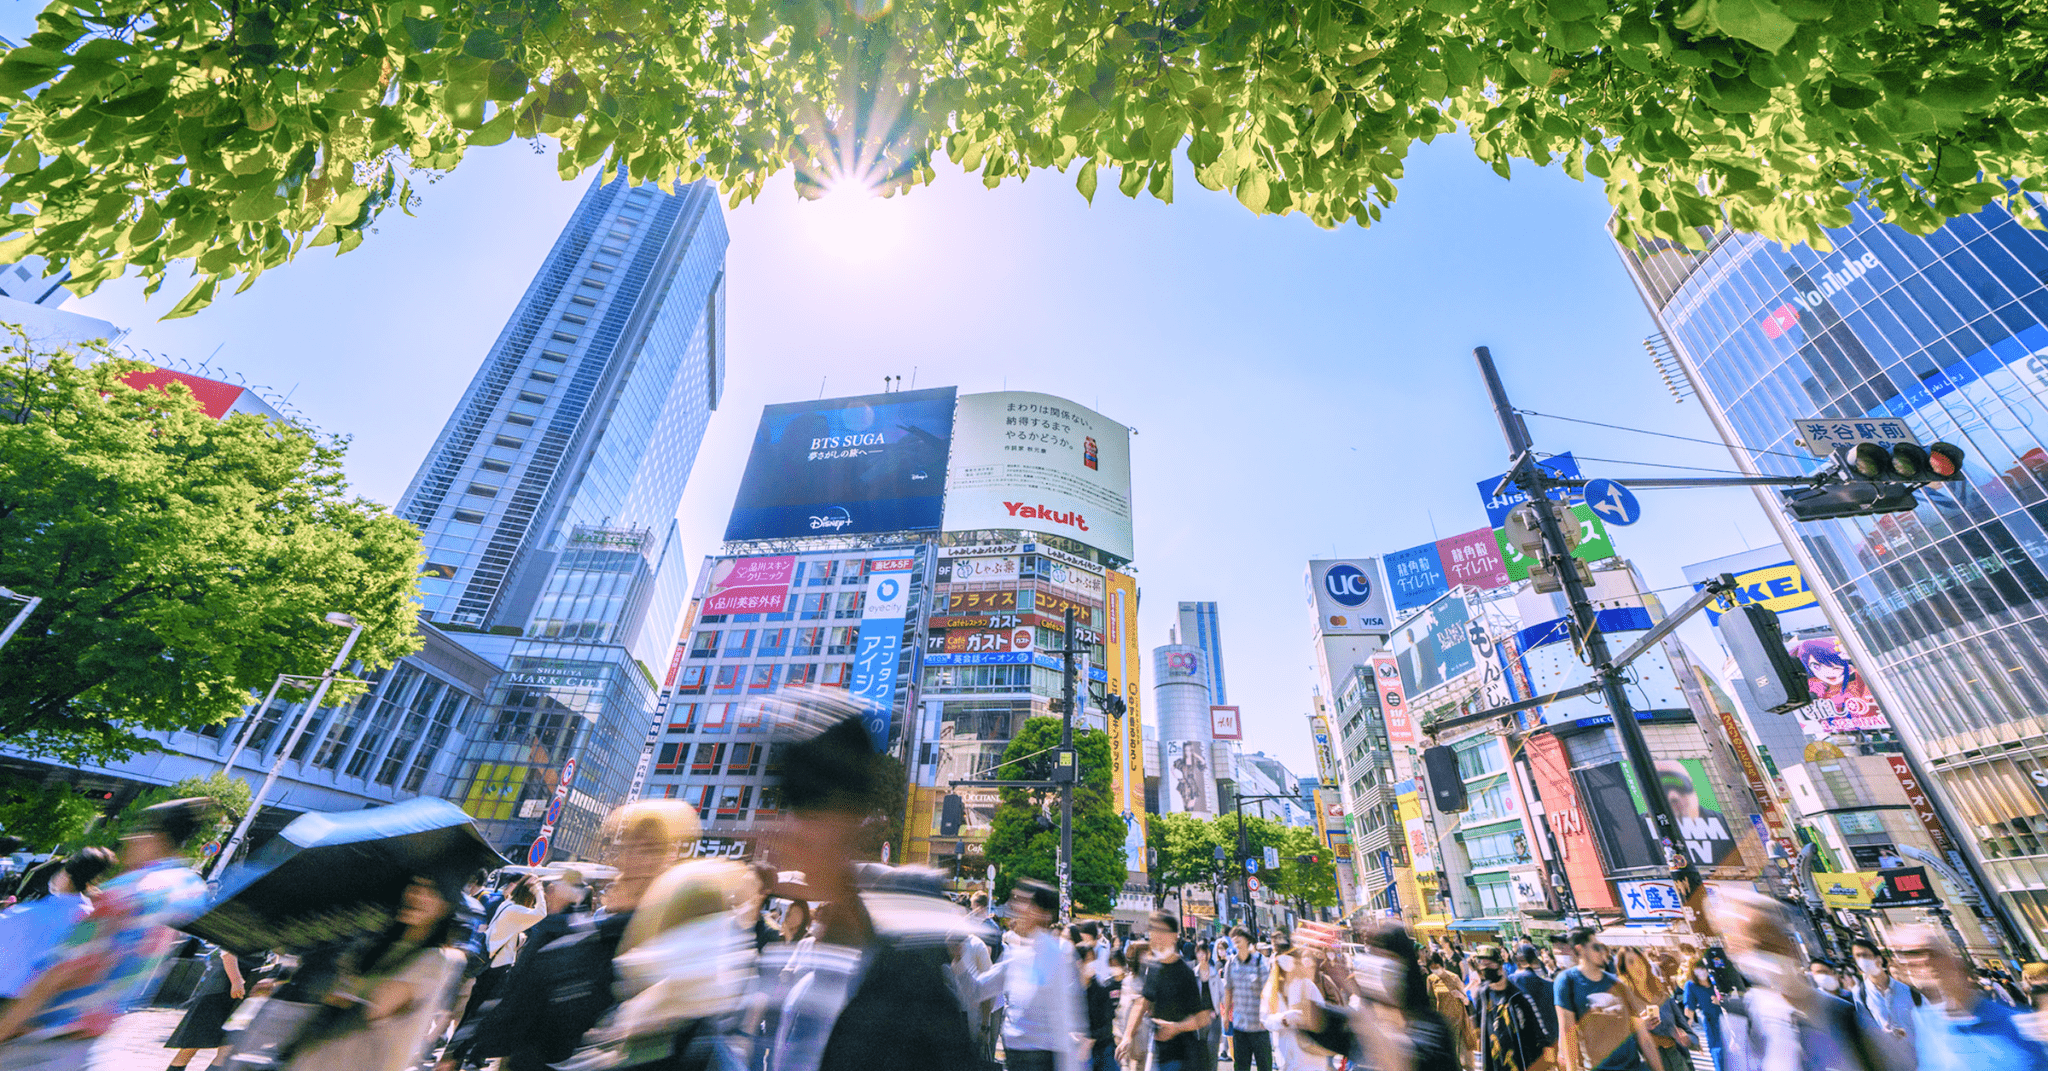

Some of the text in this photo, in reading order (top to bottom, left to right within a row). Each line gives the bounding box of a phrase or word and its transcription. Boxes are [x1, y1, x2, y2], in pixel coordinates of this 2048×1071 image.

[1792, 250, 1878, 312] YouTube
[1006, 416, 1071, 433] 納得するまで
[1007, 403, 1093, 430] まわりは関係ない。
[1005, 430, 1073, 450] やるかどうか。
[1807, 422, 1906, 441] 渋谷駅前
[810, 433, 885, 450] BTS SUGA
[809, 516, 853, 531] Disney+
[1003, 501, 1090, 532] Yakult
[948, 545, 1017, 556] しゃぶしゃぶバイキング
[1451, 541, 1488, 564] 龍角散
[749, 561, 791, 572] 品川スキン
[1047, 548, 1104, 572] しゃぶしゃぶバイキング
[1397, 556, 1430, 578] 龍角散
[747, 571, 784, 581] クリニック
[938, 566, 951, 576] 9F
[1328, 574, 1368, 596] UC
[715, 594, 781, 610] 品川美容外科
[868, 603, 902, 614] eyecity
[1035, 592, 1090, 619] コンタクト
[988, 615, 1022, 629] ガスト
[1362, 617, 1384, 626] VISA
[929, 637, 943, 647] 7F
[966, 634, 1008, 651] ガスト
[1074, 627, 1101, 645] ガスト
[853, 636, 881, 695] アイシ
[953, 653, 1015, 664] 英会話イーオン
[1166, 652, 1197, 676] 109
[508, 672, 607, 689] MARK CITY
[537, 668, 582, 677] SHIBUYA
[1723, 715, 1757, 777] クスリのことなら
[1893, 763, 1934, 823] カラオケ
[678, 839, 747, 860] ンドラッグ
